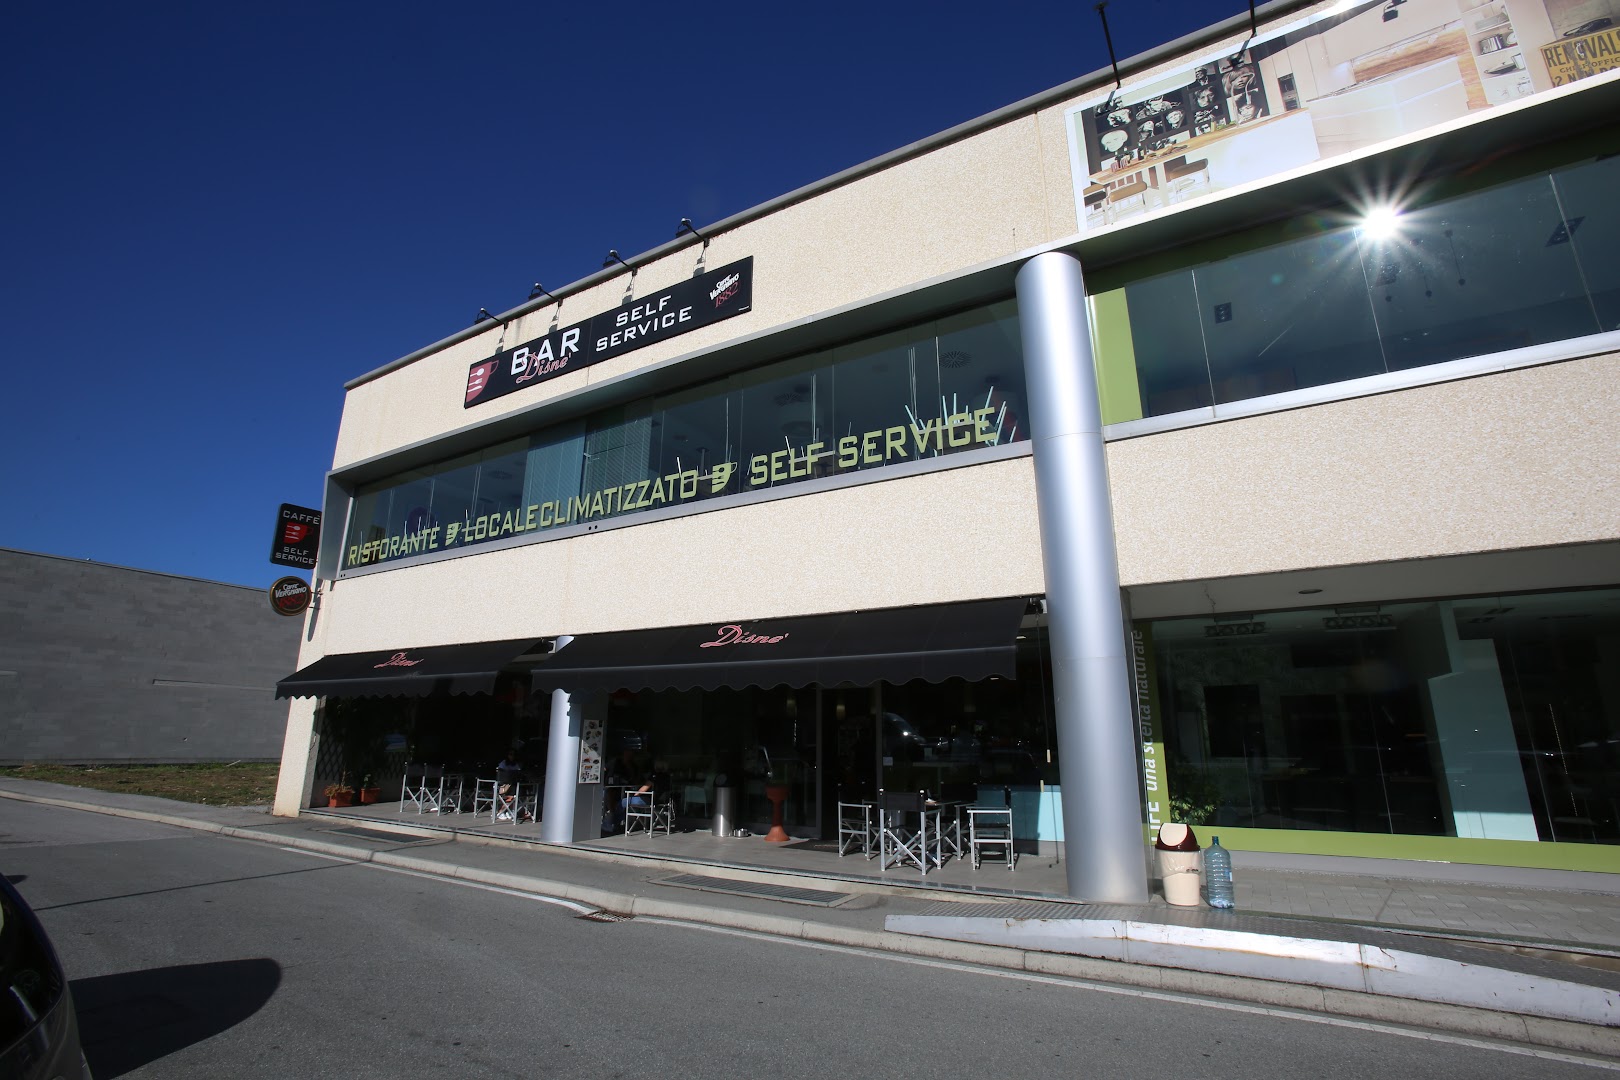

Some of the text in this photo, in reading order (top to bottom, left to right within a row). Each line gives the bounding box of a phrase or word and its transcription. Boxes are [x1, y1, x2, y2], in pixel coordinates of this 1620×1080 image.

[1560, 63, 1589, 73] CHIF
[615, 295, 672, 327] SELF
[595, 306, 693, 351] SERVICE
[511, 327, 580, 376] BAR
[347, 526, 441, 566] RISTORANTE
[750, 442, 824, 485] SELF
[838, 407, 997, 468] SERVICE
[275, 552, 315, 565] SERVICE
[283, 546, 309, 556] SELF
[1145, 758, 1158, 791] una
